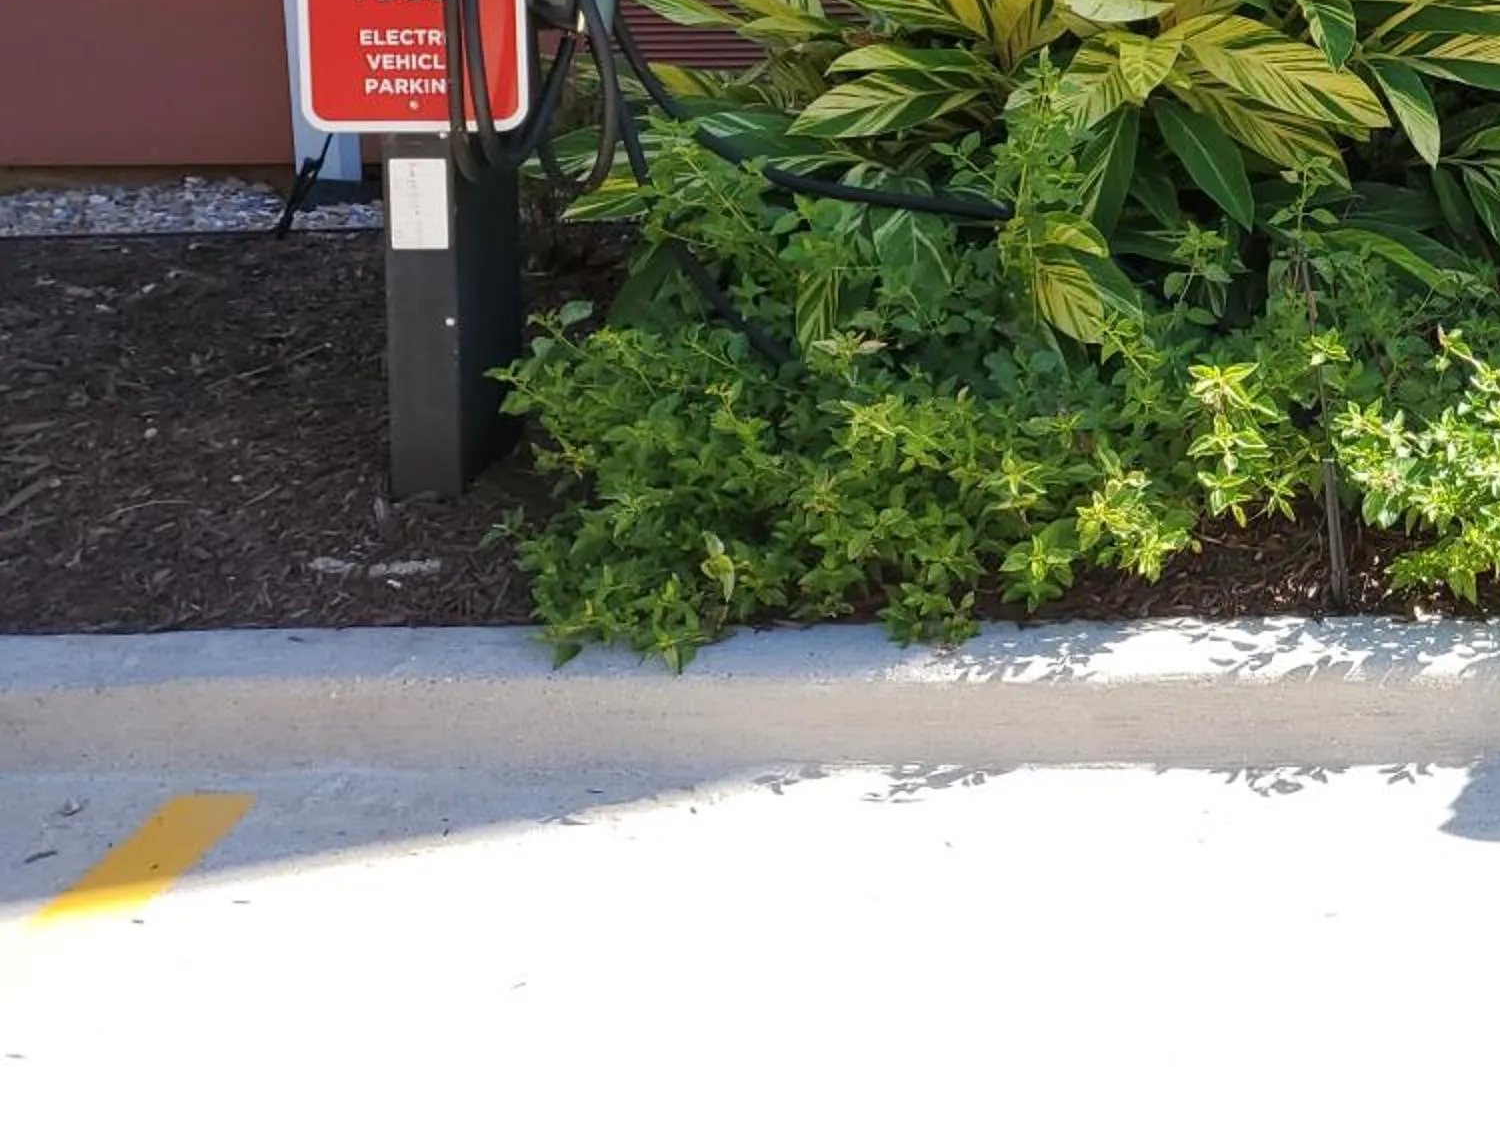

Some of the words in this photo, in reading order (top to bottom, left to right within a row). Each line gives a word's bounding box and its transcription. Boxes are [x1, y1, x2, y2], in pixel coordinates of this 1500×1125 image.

[359, 29, 447, 46] ELECTR
[366, 54, 446, 71] VEHICL
[365, 78, 446, 95] PARKIN
